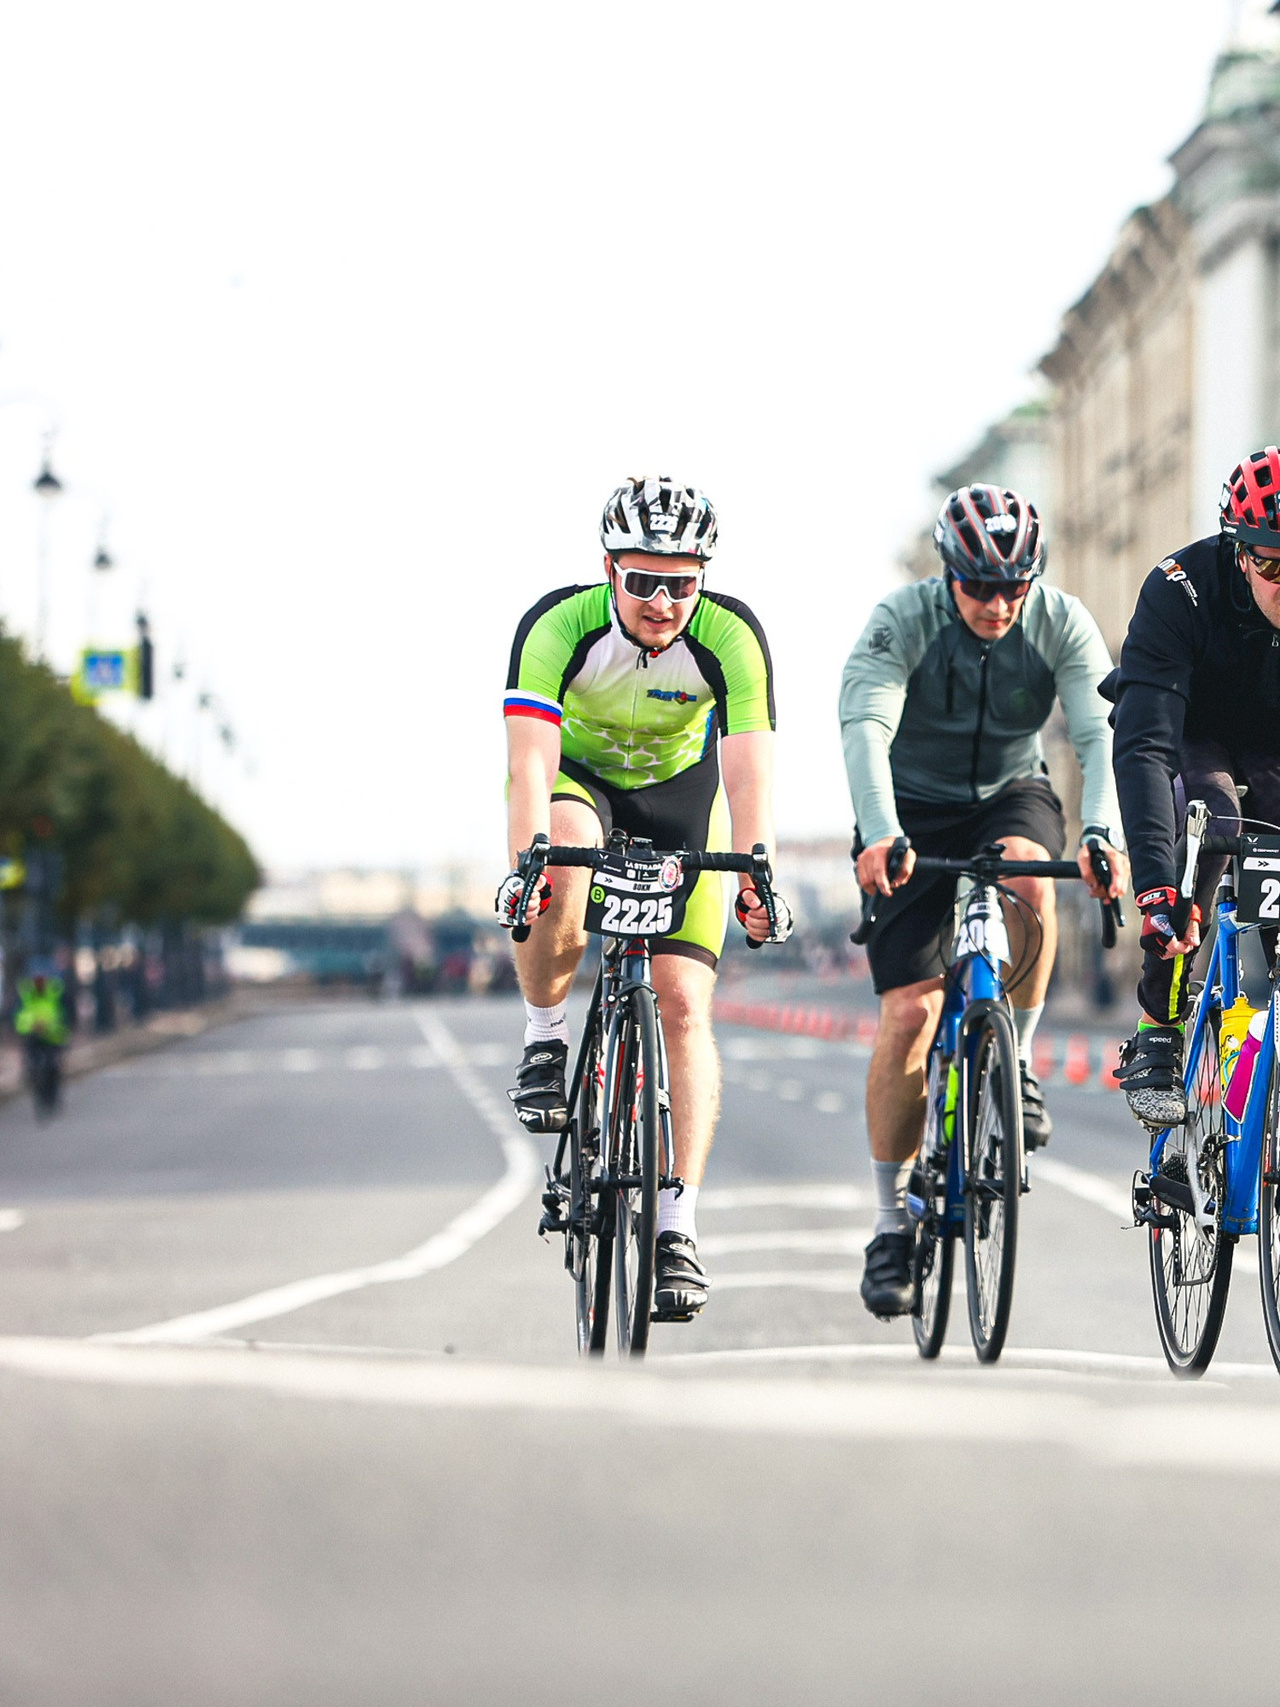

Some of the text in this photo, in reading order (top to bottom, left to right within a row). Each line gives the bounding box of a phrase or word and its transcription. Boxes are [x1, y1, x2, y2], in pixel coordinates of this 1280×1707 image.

[984, 514, 1017, 533] 20
[625, 860, 634, 869] LA
[594, 888, 602, 900] B
[601, 894, 673, 934] 2225
